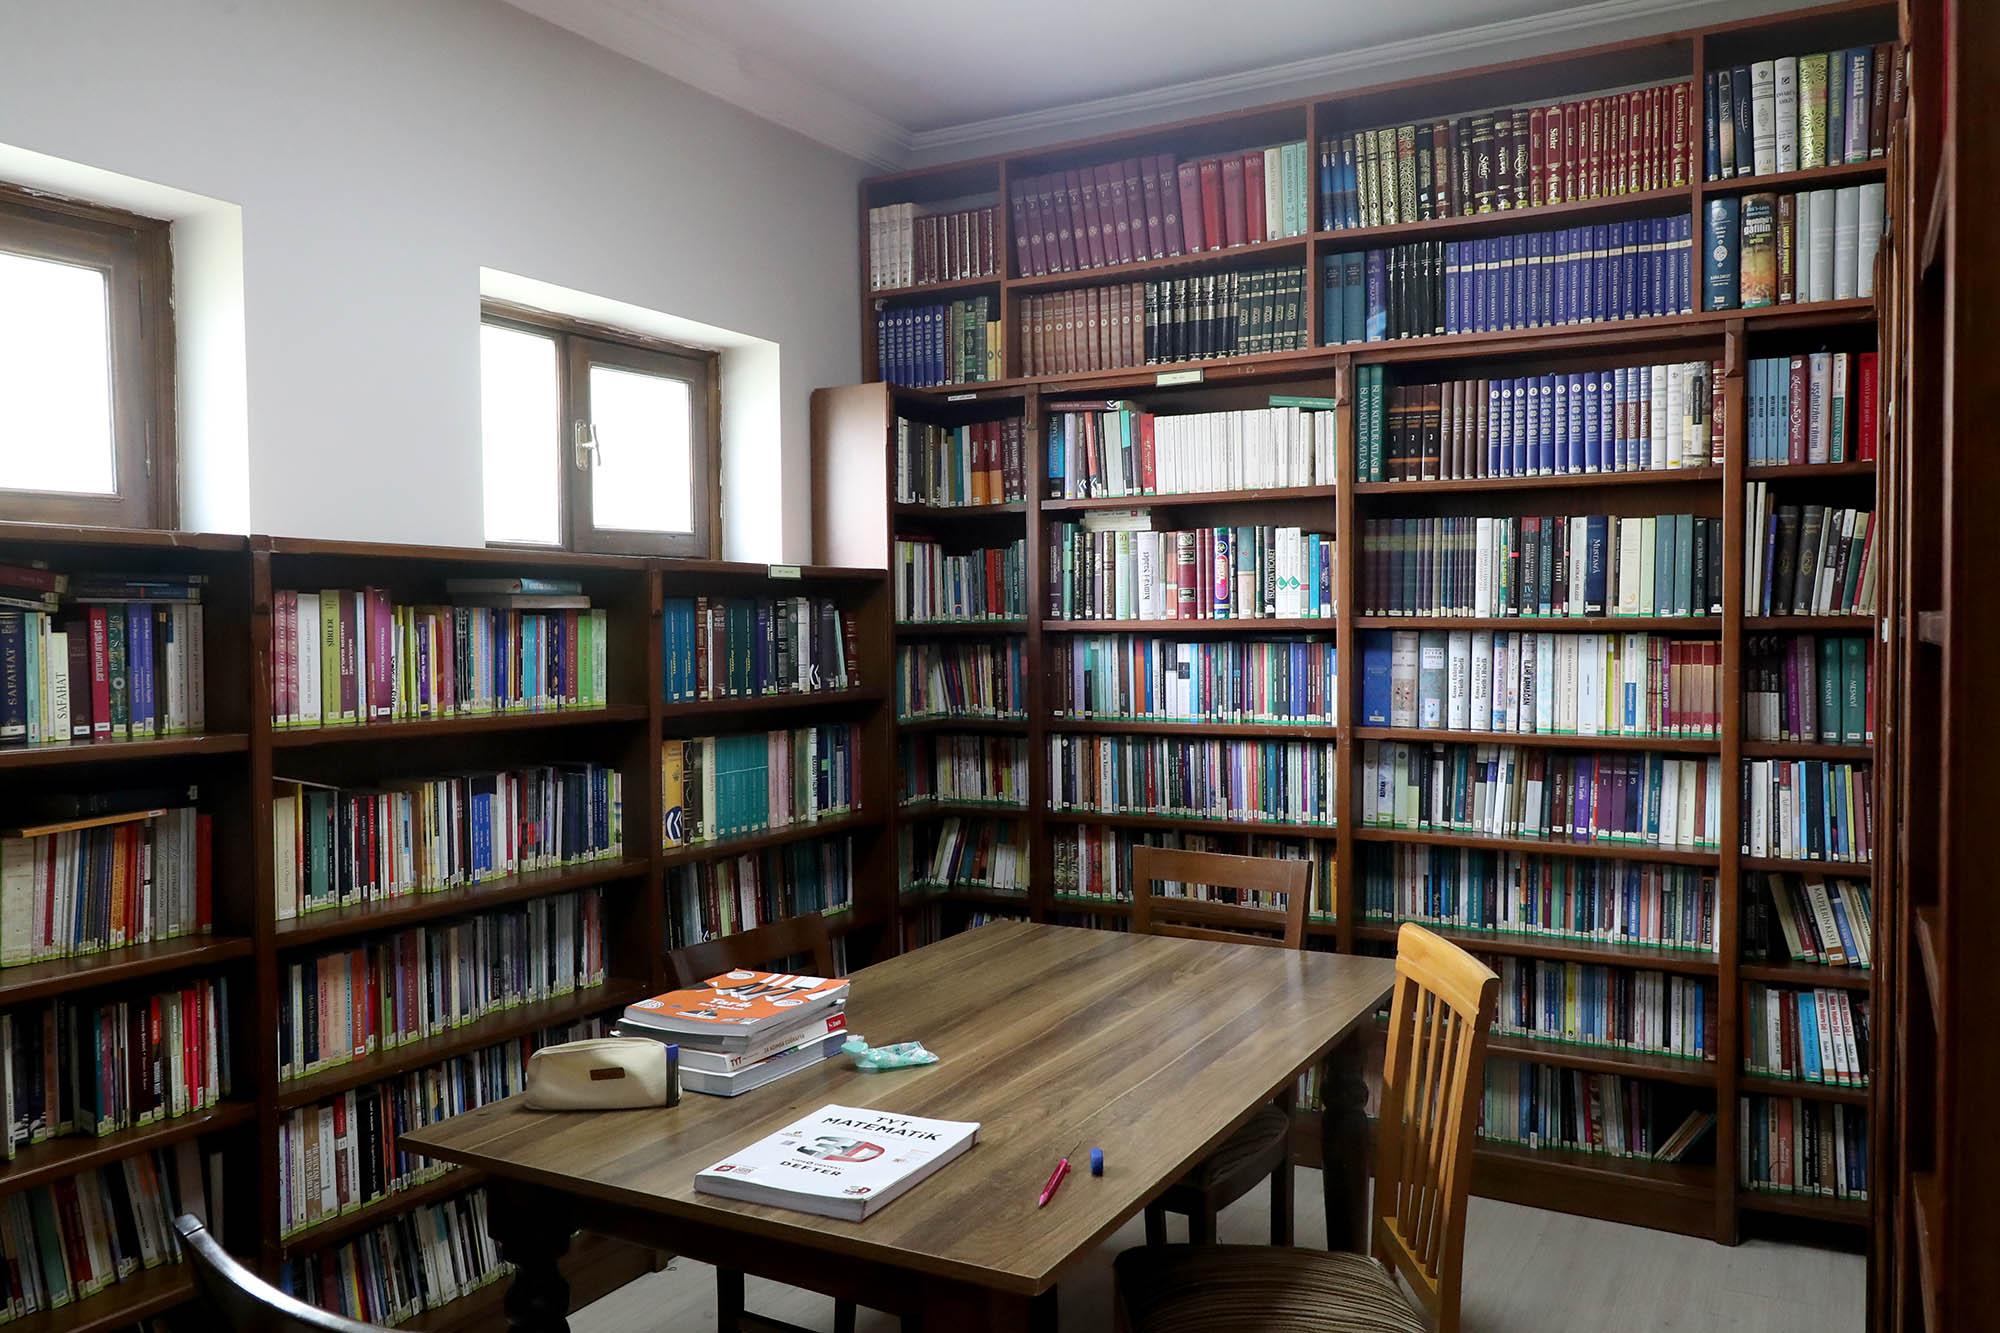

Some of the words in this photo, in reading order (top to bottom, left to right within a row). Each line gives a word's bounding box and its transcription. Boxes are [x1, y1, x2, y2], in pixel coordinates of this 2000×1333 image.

[6, 647, 17, 705] SAFAHAT
[55, 672, 67, 719] SAFAHAT
[731, 1057, 743, 1069] TYT
[875, 1116, 913, 1127] TYT
[779, 1160, 843, 1177] DEFTER
